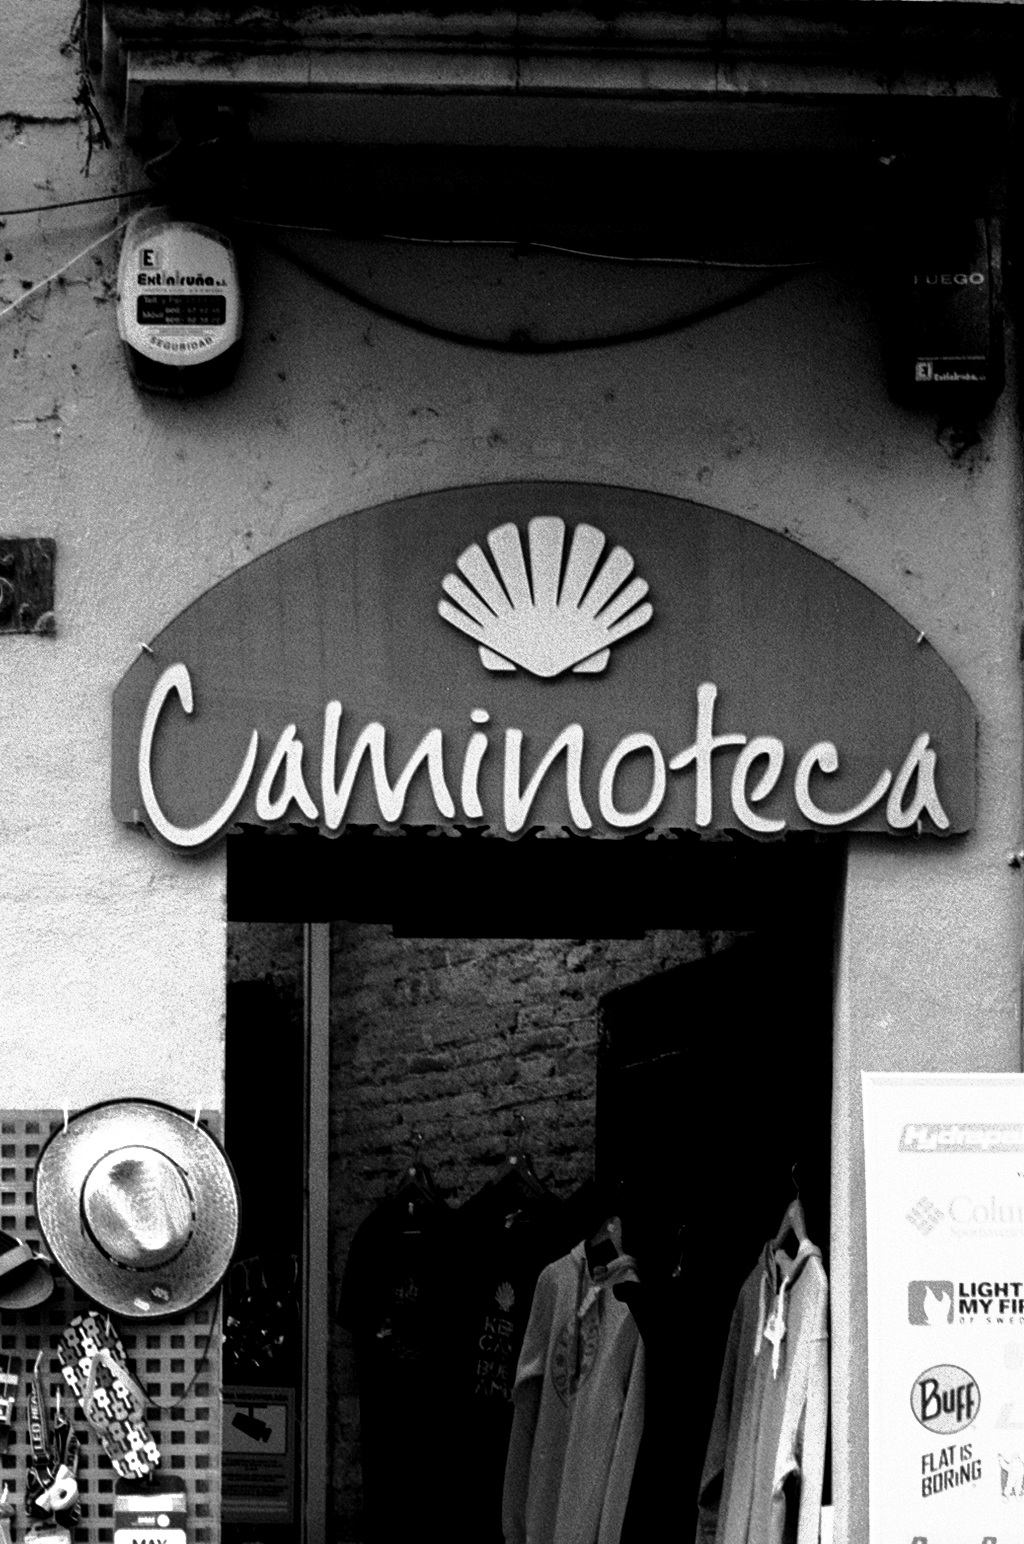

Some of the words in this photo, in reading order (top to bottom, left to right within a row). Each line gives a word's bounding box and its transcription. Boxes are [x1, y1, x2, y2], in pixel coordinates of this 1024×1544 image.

[913, 272, 985, 285] FUEGO
[150, 336, 213, 352] SEGURIDAD
[138, 662, 950, 848] Caminoteca
[905, 1125, 1024, 1150] Hydrapa
[959, 1282, 1023, 1298] LIGHT
[959, 1299, 993, 1315] MY
[919, 1378, 975, 1423] Buff
[921, 1446, 957, 1475] FLAT
[959, 1443, 974, 1462] IS
[921, 1459, 983, 1498] BORING
